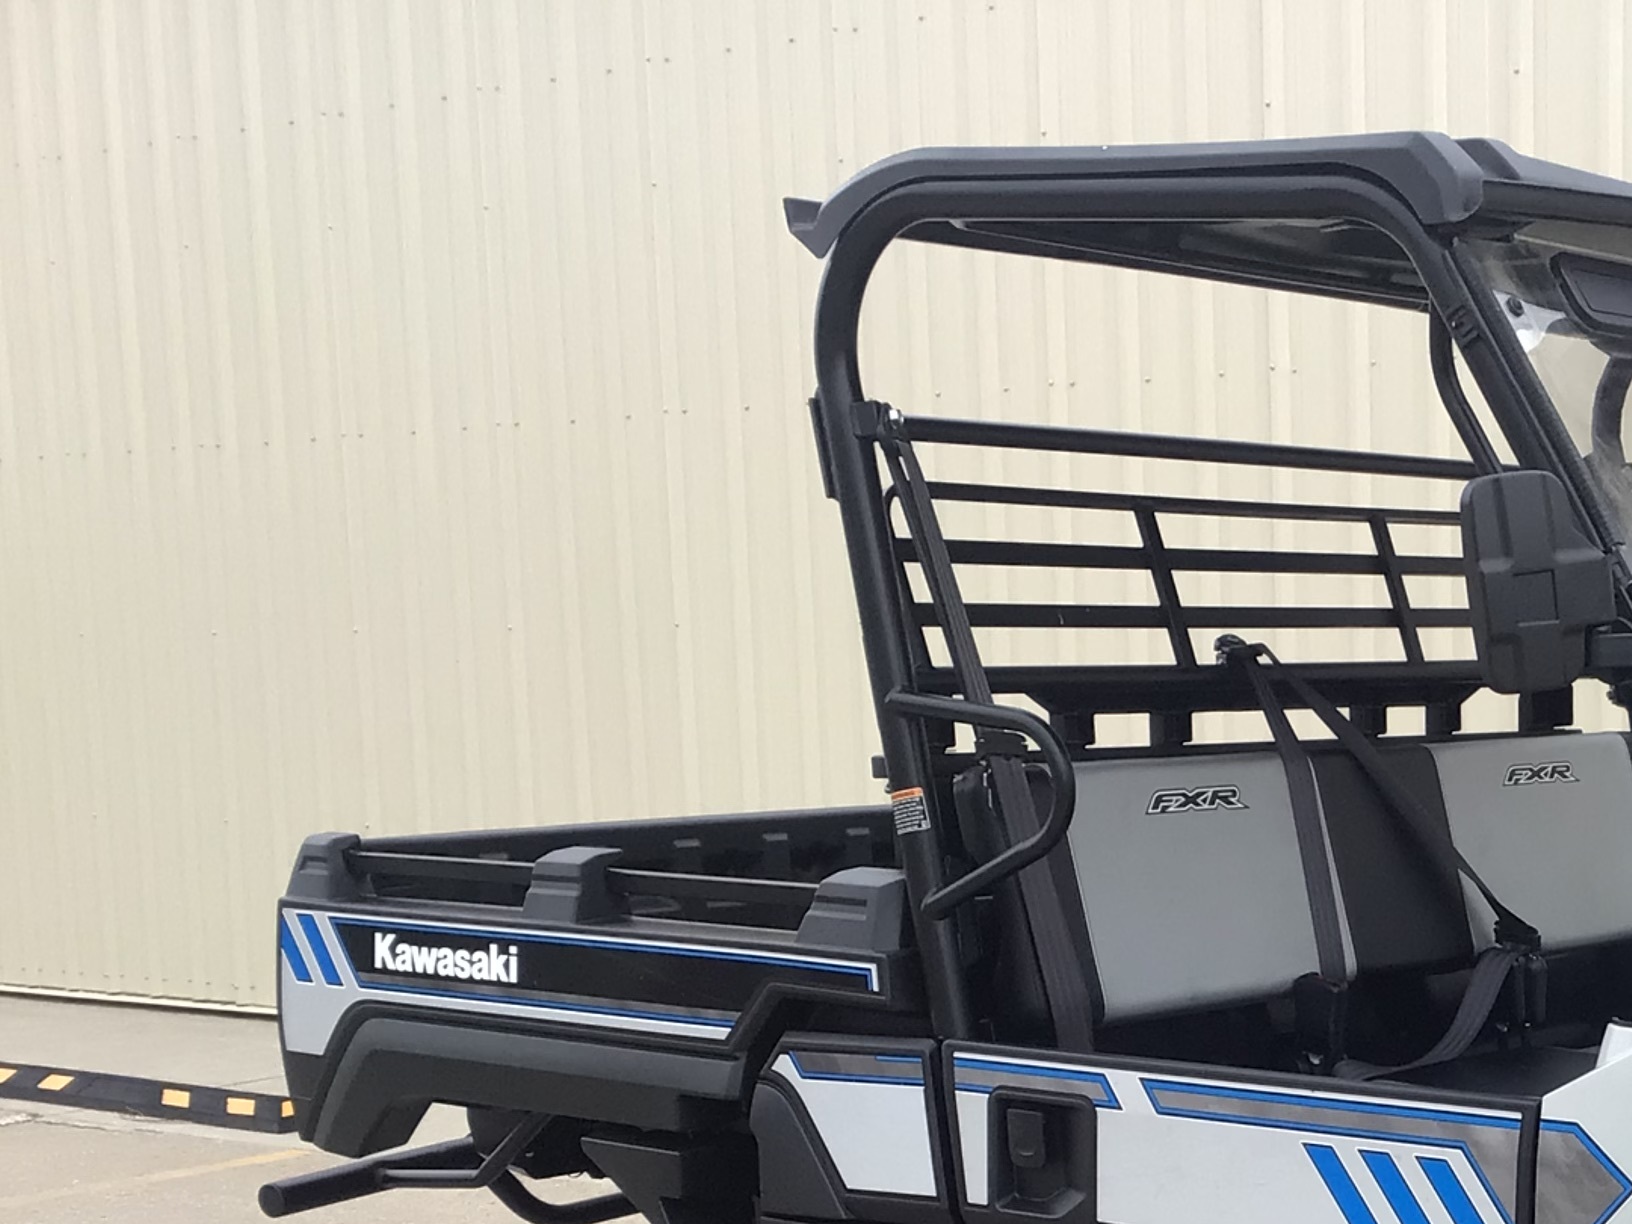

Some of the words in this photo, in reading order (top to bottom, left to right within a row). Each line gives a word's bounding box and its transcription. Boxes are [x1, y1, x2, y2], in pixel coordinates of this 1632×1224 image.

[1503, 761, 1578, 785] FXR
[1146, 785, 1247, 814] FXR
[374, 932, 518, 983] Kawasaki
